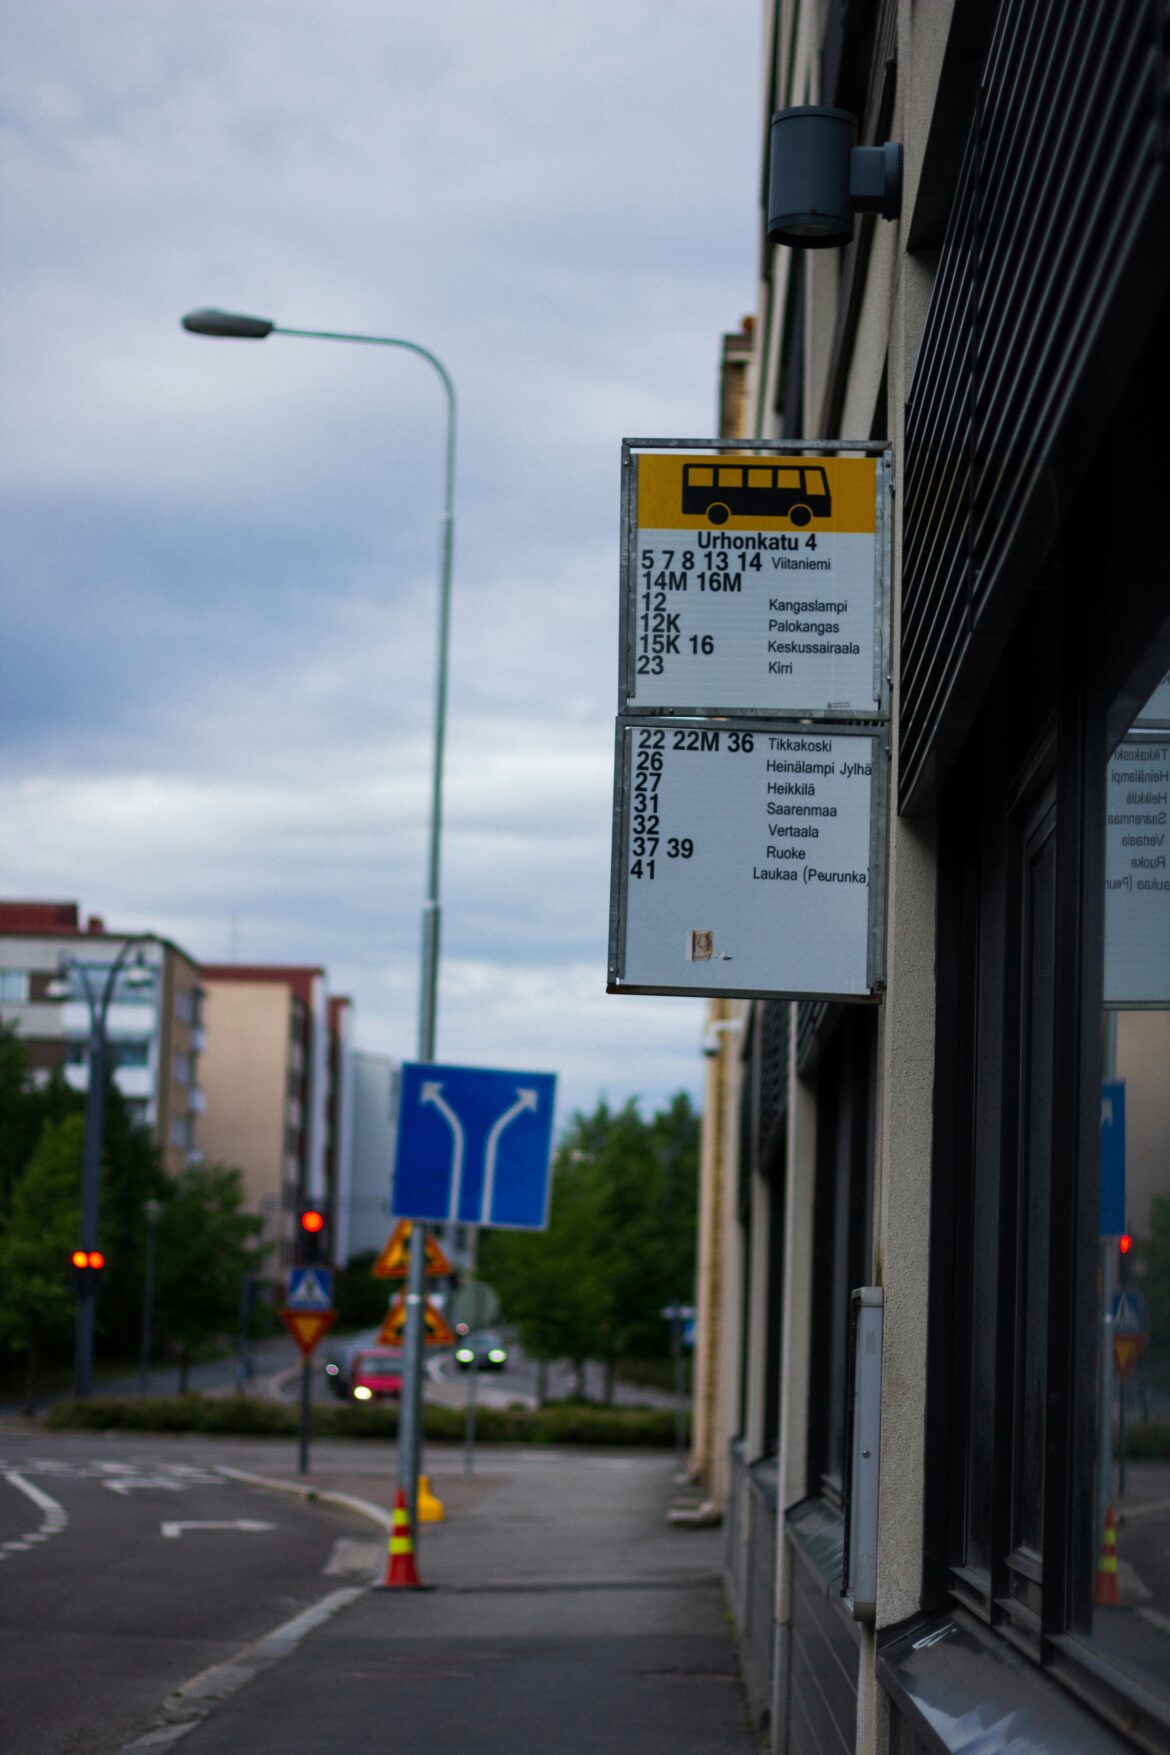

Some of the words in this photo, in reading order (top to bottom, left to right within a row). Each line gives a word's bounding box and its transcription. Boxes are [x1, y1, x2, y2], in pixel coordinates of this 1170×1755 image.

[697, 531, 798, 551] Urhonkatu
[805, 533, 817, 551] 4
[641, 550, 654, 570] 5
[662, 550, 674, 570] 7
[682, 551, 694, 570] 8
[704, 551, 728, 571] 13
[738, 552, 762, 571] 14
[772, 557, 830, 570] Viitaniemi
[642, 571, 687, 591] 14M
[697, 572, 741, 592] 16M
[642, 592, 666, 612] 12
[769, 599, 847, 615] Kangaslampi
[640, 613, 680, 633] 12K
[769, 619, 839, 636] Palokangas
[640, 634, 680, 654] 15K
[689, 635, 714, 655] 16
[768, 641, 859, 654] Keskussairaala
[637, 655, 664, 675] 23
[769, 662, 792, 674] Kirri
[639, 729, 665, 749] 22
[673, 730, 719, 752] 22M
[728, 732, 754, 752] 36
[769, 738, 832, 752] Tikkakoski
[636, 751, 663, 771] 26
[766, 760, 834, 777] Heinälampi
[840, 762, 872, 778] Jylhä
[634, 772, 661, 792] 27
[767, 782, 815, 795] Heikkilä
[634, 793, 658, 813] 31
[767, 802, 837, 816] Saarenmaa
[633, 814, 659, 835] 32
[768, 824, 818, 838] Vertaala
[632, 836, 659, 857] 37
[666, 838, 693, 858] 39
[766, 846, 806, 859] Ruoke
[630, 859, 655, 879] 41
[753, 867, 797, 880] Laukaa
